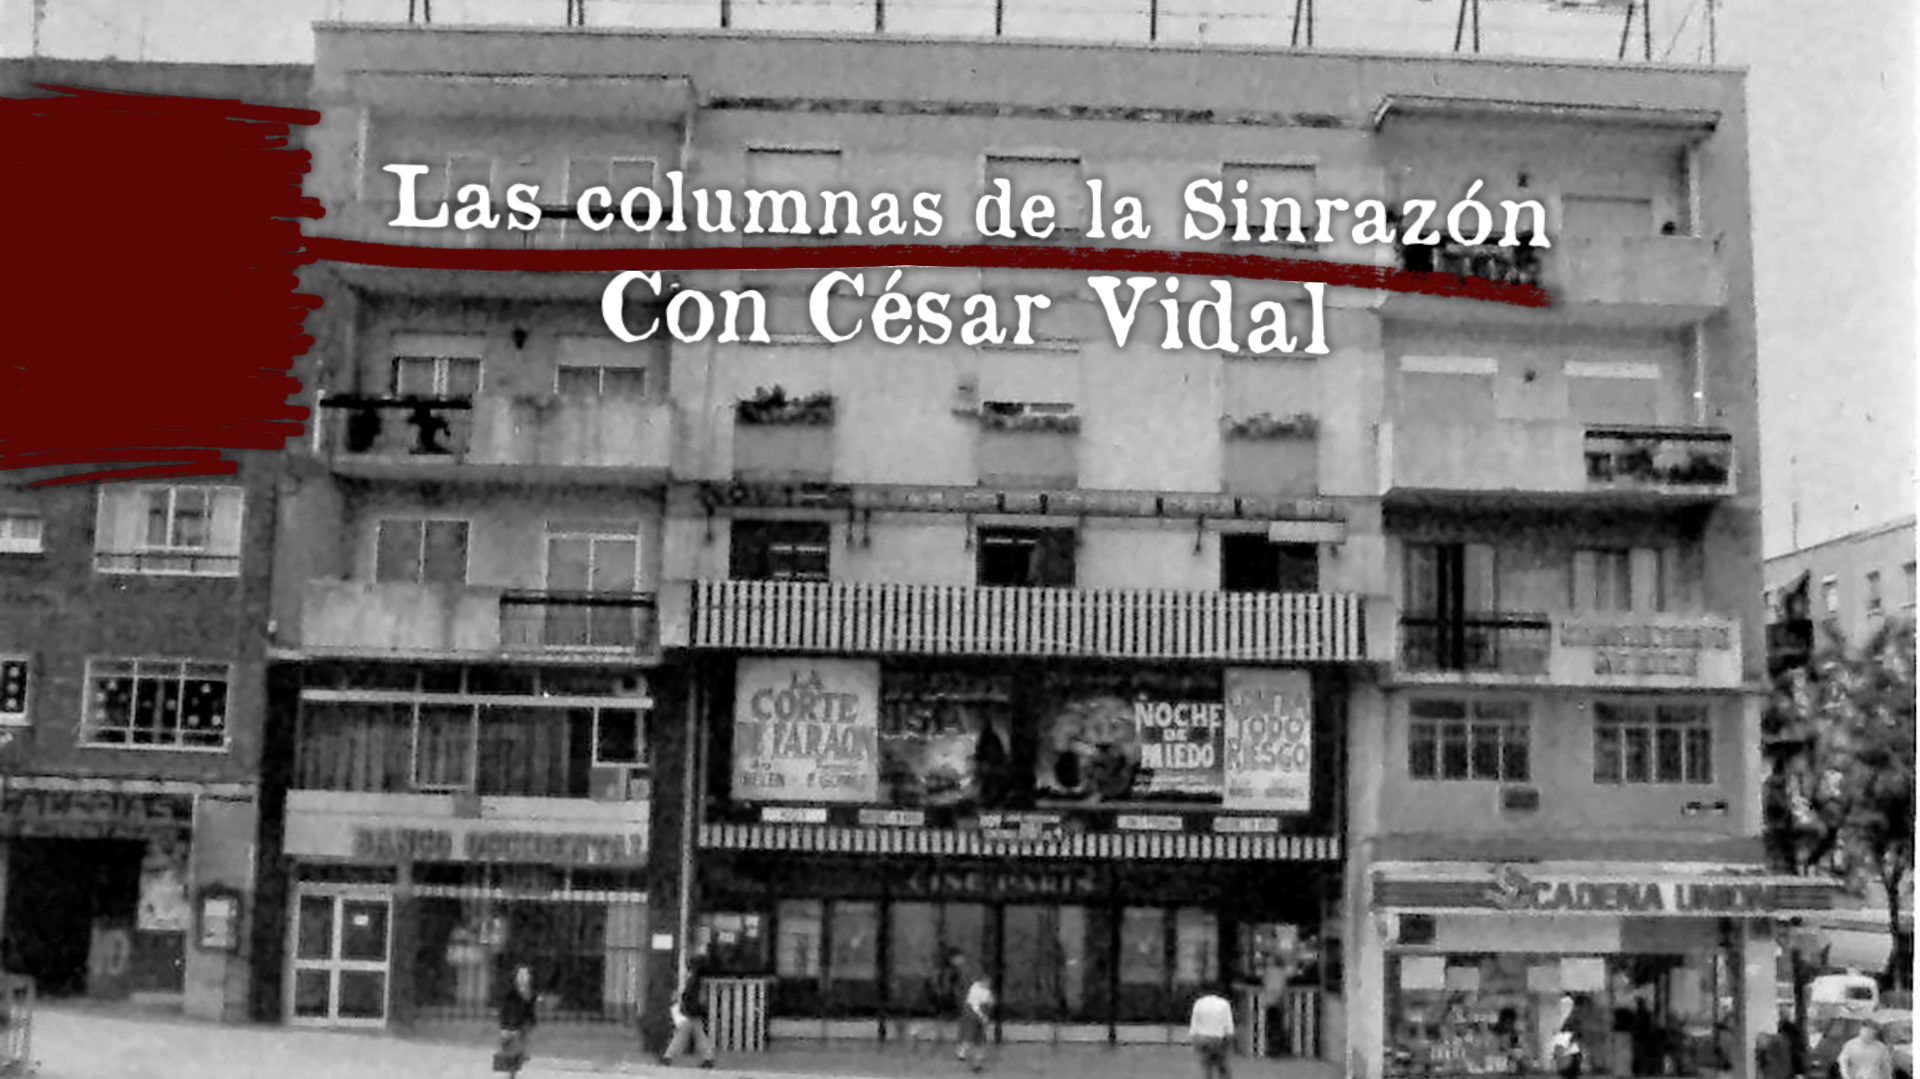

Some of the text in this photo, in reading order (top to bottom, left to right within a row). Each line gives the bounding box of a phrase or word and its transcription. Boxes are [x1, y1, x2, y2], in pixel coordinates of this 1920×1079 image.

[790, 669, 824, 691] LA
[751, 688, 860, 724] CORTE
[1134, 702, 1224, 729] NOCHE
[1163, 728, 1188, 741] DE
[1141, 743, 1215, 769] MIEDO
[1533, 879, 1661, 911] CADENA
